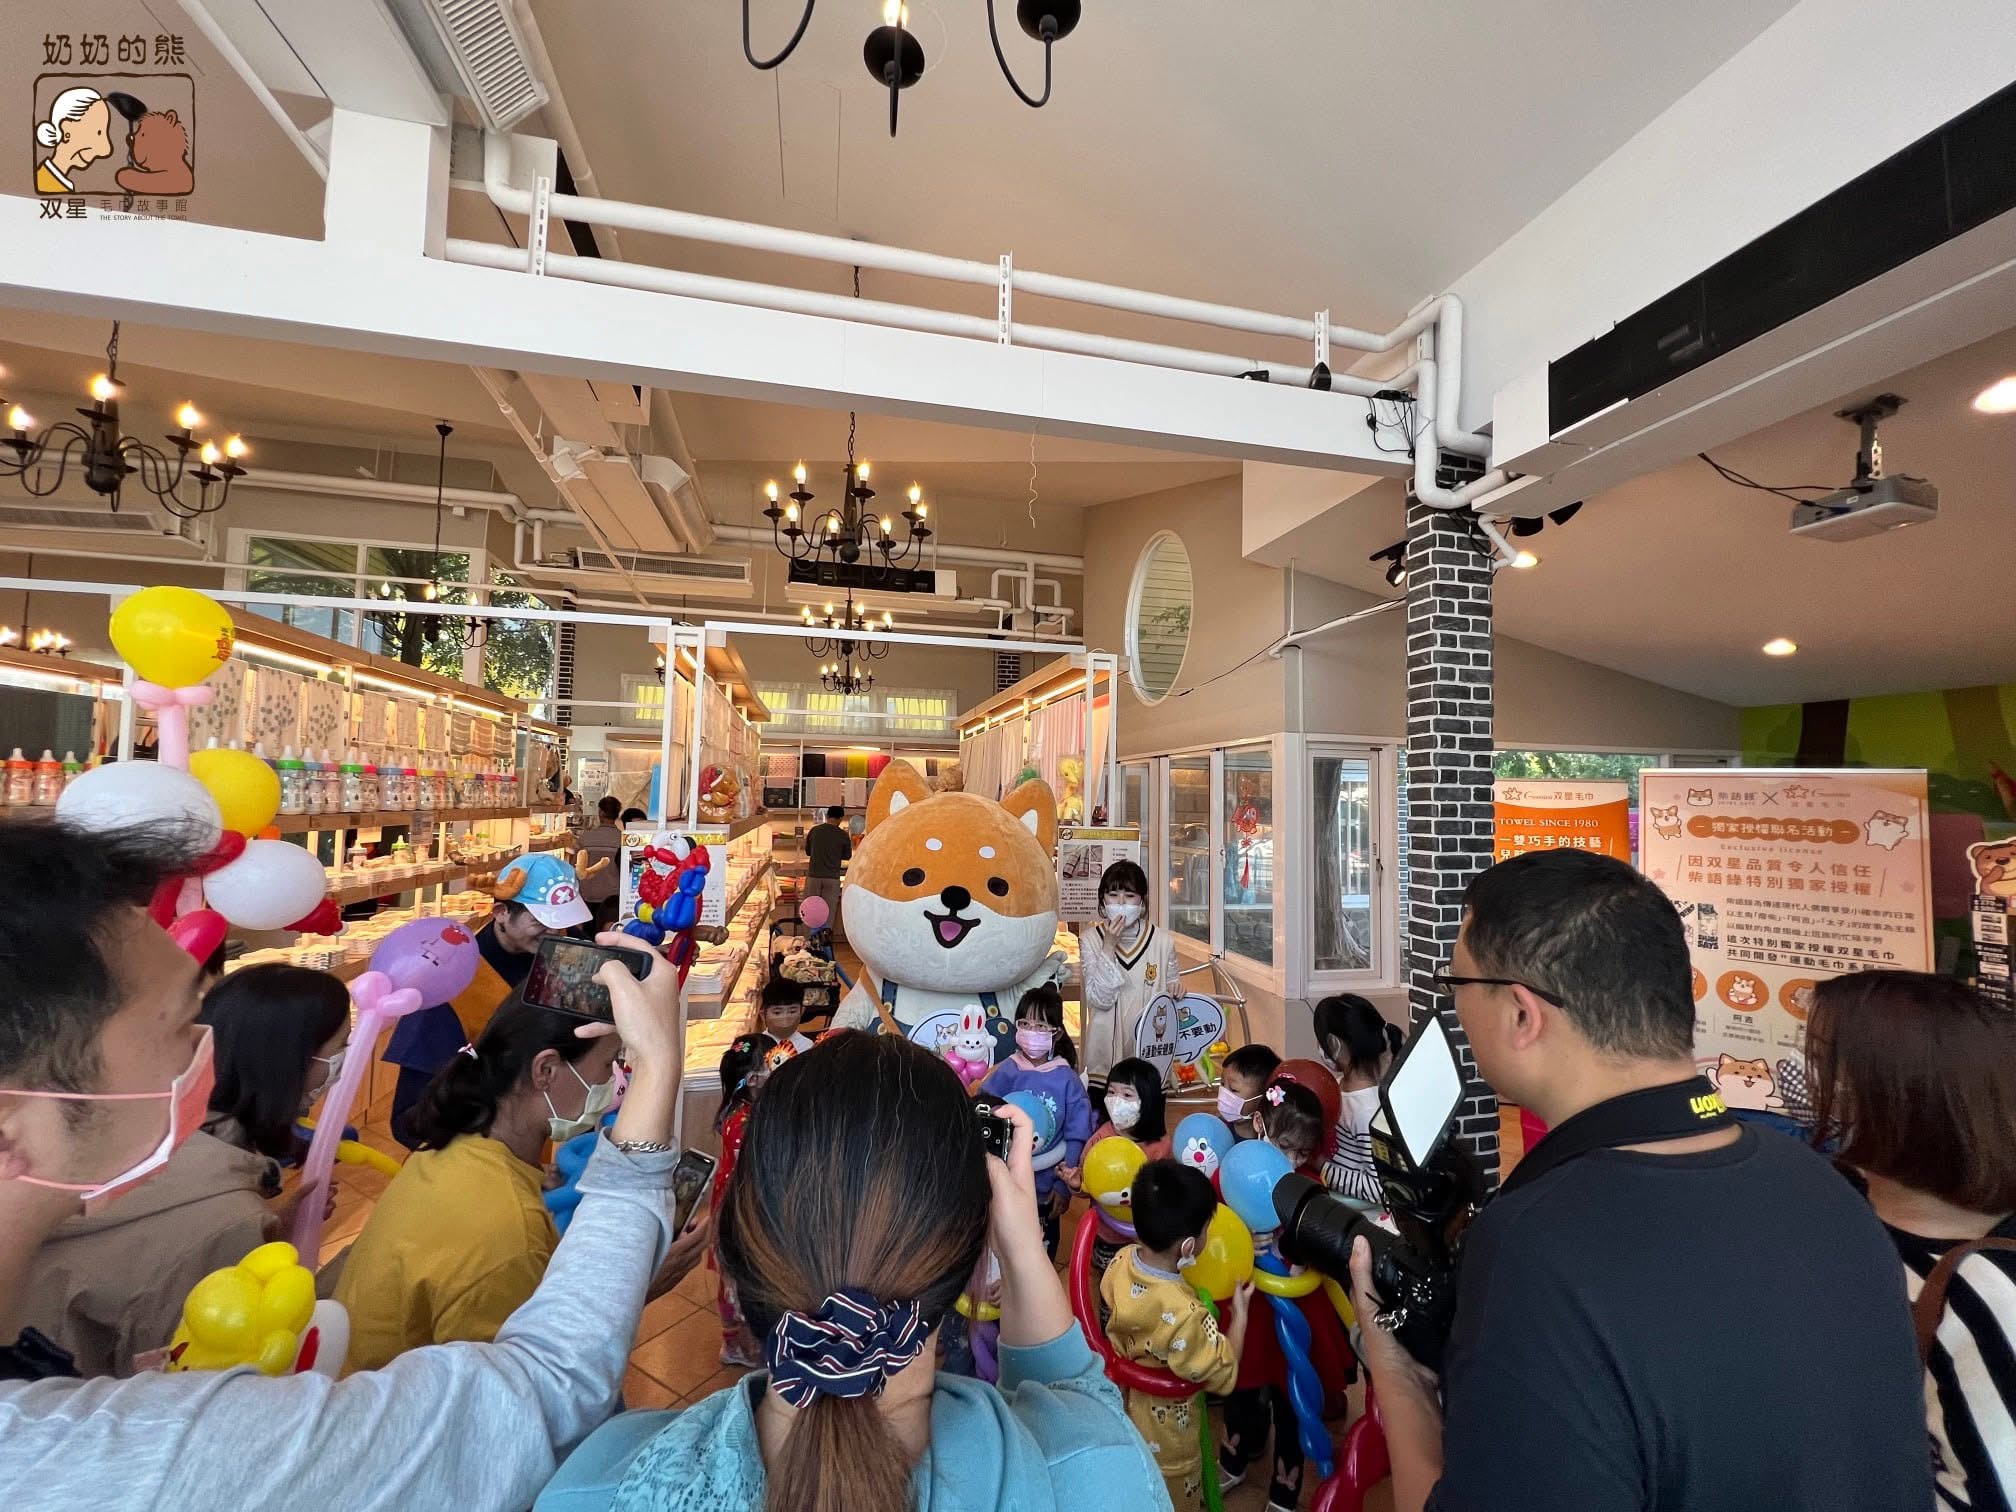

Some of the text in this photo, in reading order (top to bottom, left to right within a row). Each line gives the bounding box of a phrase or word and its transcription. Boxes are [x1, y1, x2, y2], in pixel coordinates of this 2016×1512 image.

[1553, 791, 1595, 801] 双星毛巾
[1499, 817, 1599, 828] TOWEL SINCE 1980
[1711, 821, 1834, 838] 獨家授權聯名活動
[1499, 835, 1602, 848] 一雙巧手的技藝
[1688, 855, 1872, 878] 因双星品質令人信任
[1688, 871, 1872, 896] 柴語錄特別獨家授權
[1727, 935, 1896, 960] 這次特別獨家授權双星毛巾
